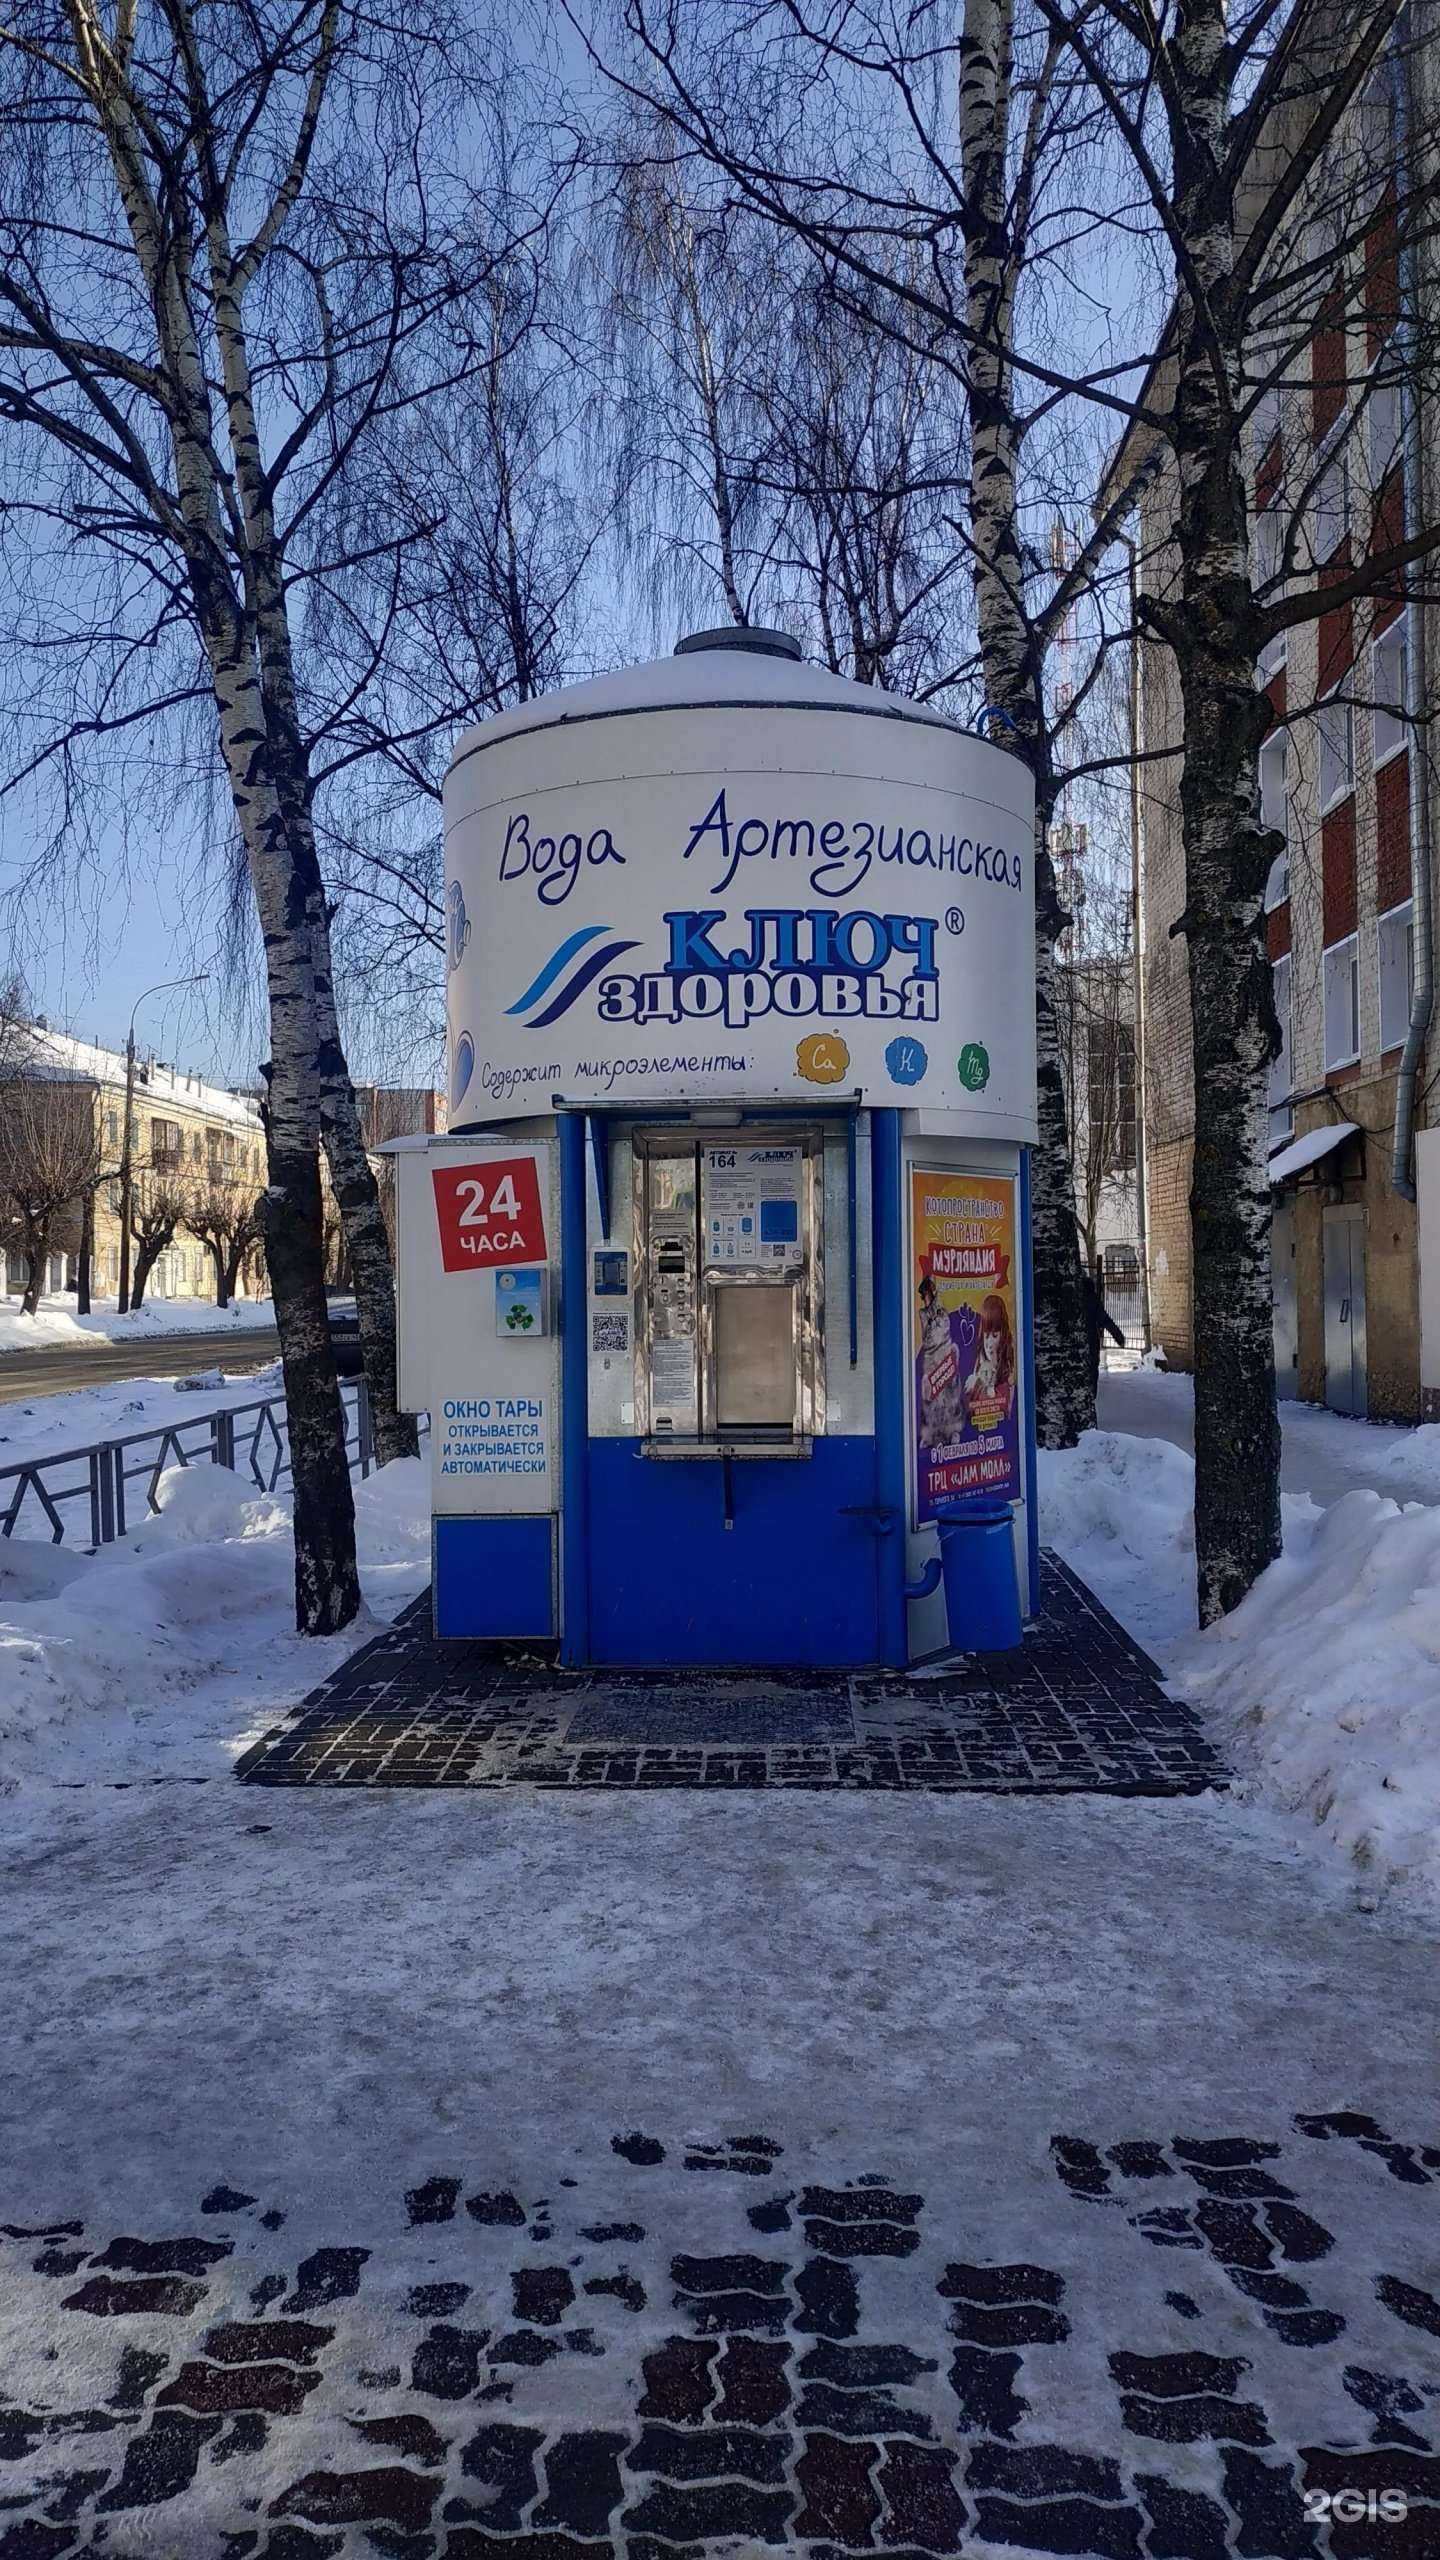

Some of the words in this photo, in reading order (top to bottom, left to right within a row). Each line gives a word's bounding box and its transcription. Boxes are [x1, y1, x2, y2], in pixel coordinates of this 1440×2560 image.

[499, 814, 626, 906] Вода
[683, 787, 1023, 897] Артезианская
[811, 1044, 837, 1071] Ca
[481, 1062, 561, 1099] Содержит
[575, 1053, 755, 1090] микроэлементы:
[709, 1155, 736, 1168] 164
[455, 1174, 522, 1227] 24
[459, 1231, 527, 1254] ЧАСА
[944, 1220, 986, 1244] СТРАНА
[933, 1249, 996, 1274] МУРЛЯНДИЯ
[443, 1400, 491, 1418] ОКНО
[496, 1400, 543, 1418] ТАРЫ
[448, 1424, 539, 1437] ОТКРЫВАЕТСЯ
[443, 1443, 451, 1456] И
[454, 1442, 544, 1456] ЗАКРЫВАЕТСЯ
[978, 1435, 986, 1455] 5
[441, 1461, 546, 1474] АВТОМАТИЧЕСКИ
[928, 1470, 948, 1492] ТРЦ
